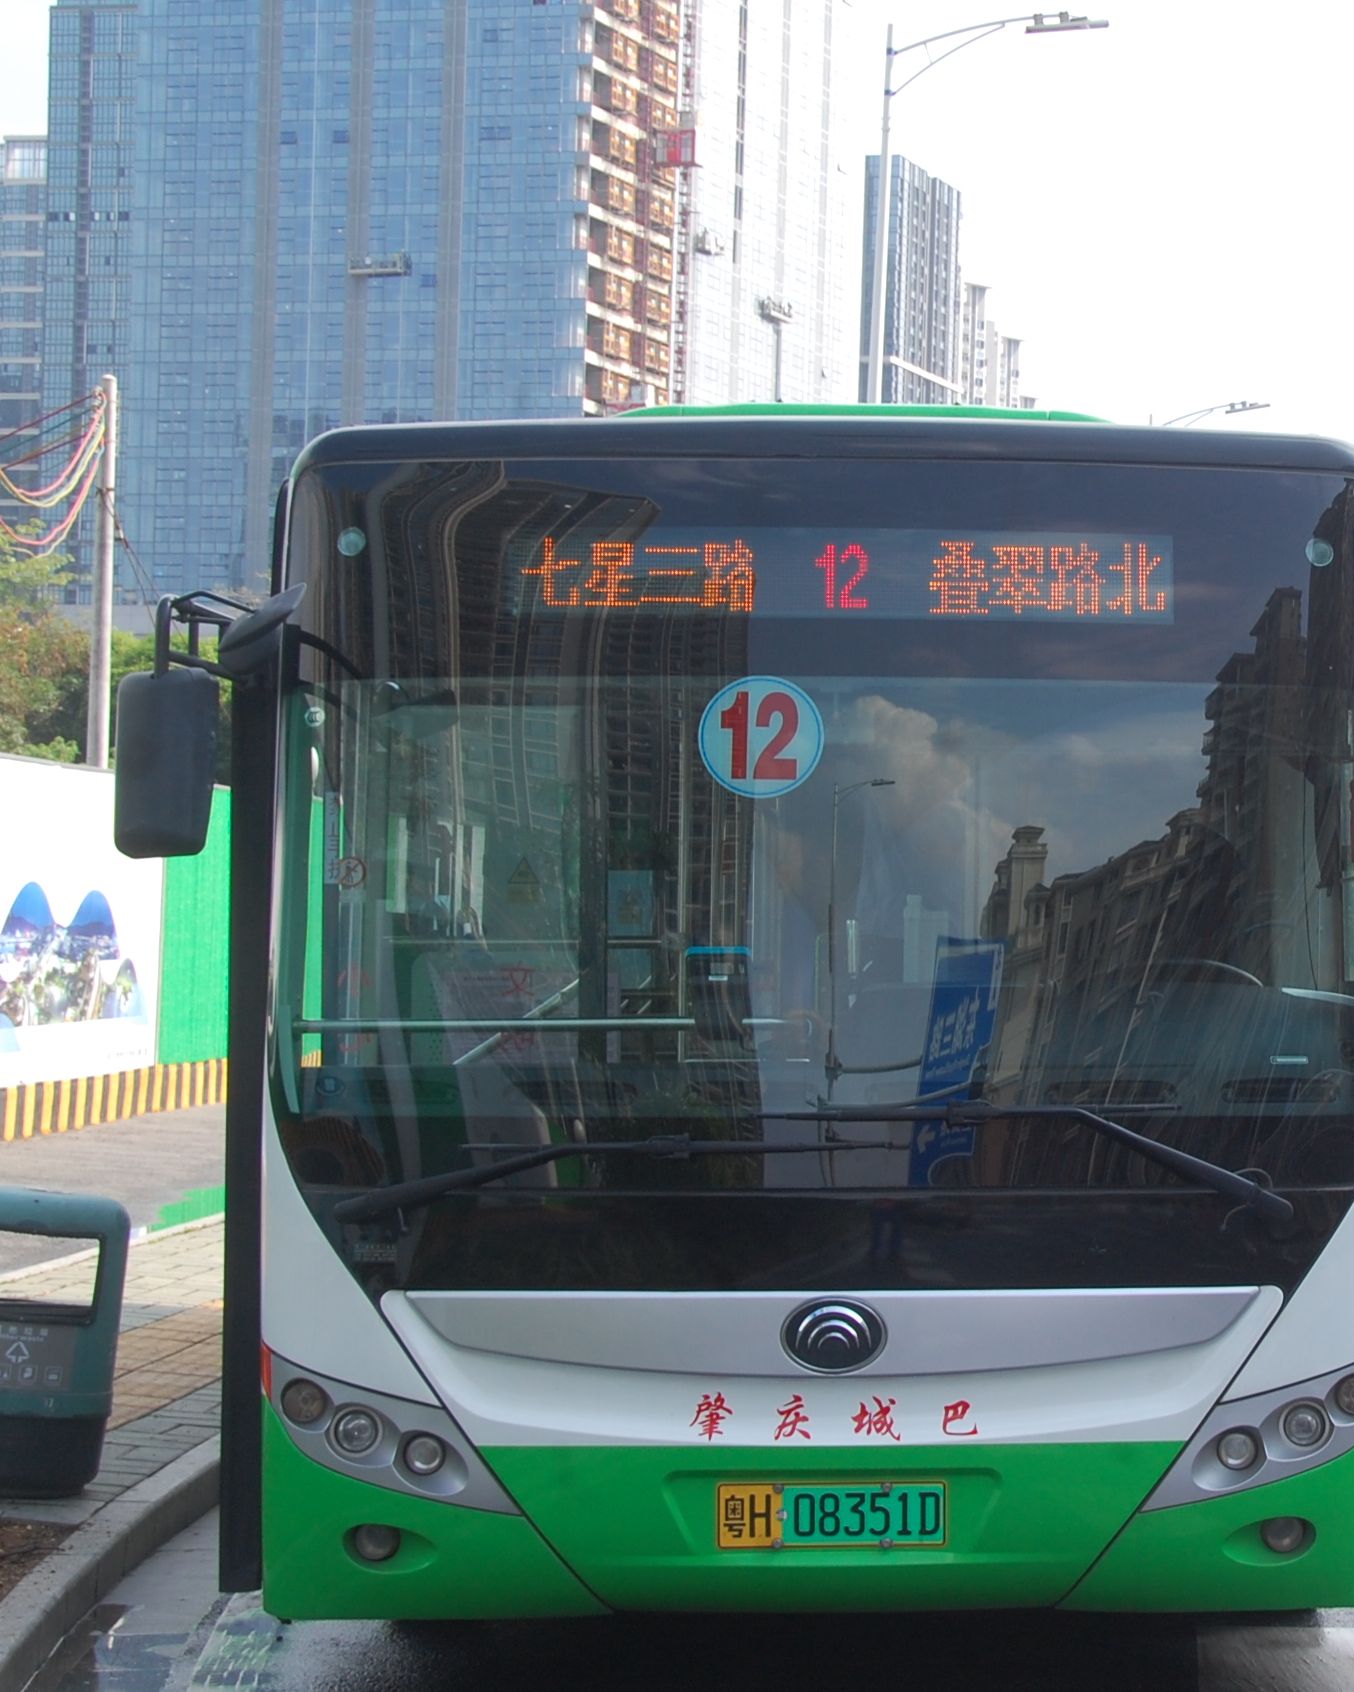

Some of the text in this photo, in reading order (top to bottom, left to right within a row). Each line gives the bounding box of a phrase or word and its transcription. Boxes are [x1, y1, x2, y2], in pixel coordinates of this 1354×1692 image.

[521, 537, 1165, 614] 七星三路 12 叠翠路北
[720, 691, 799, 780] 12
[689, 1392, 978, 1441] 肇庆城巴
[724, 1492, 941, 1538] 粤H 08351D
